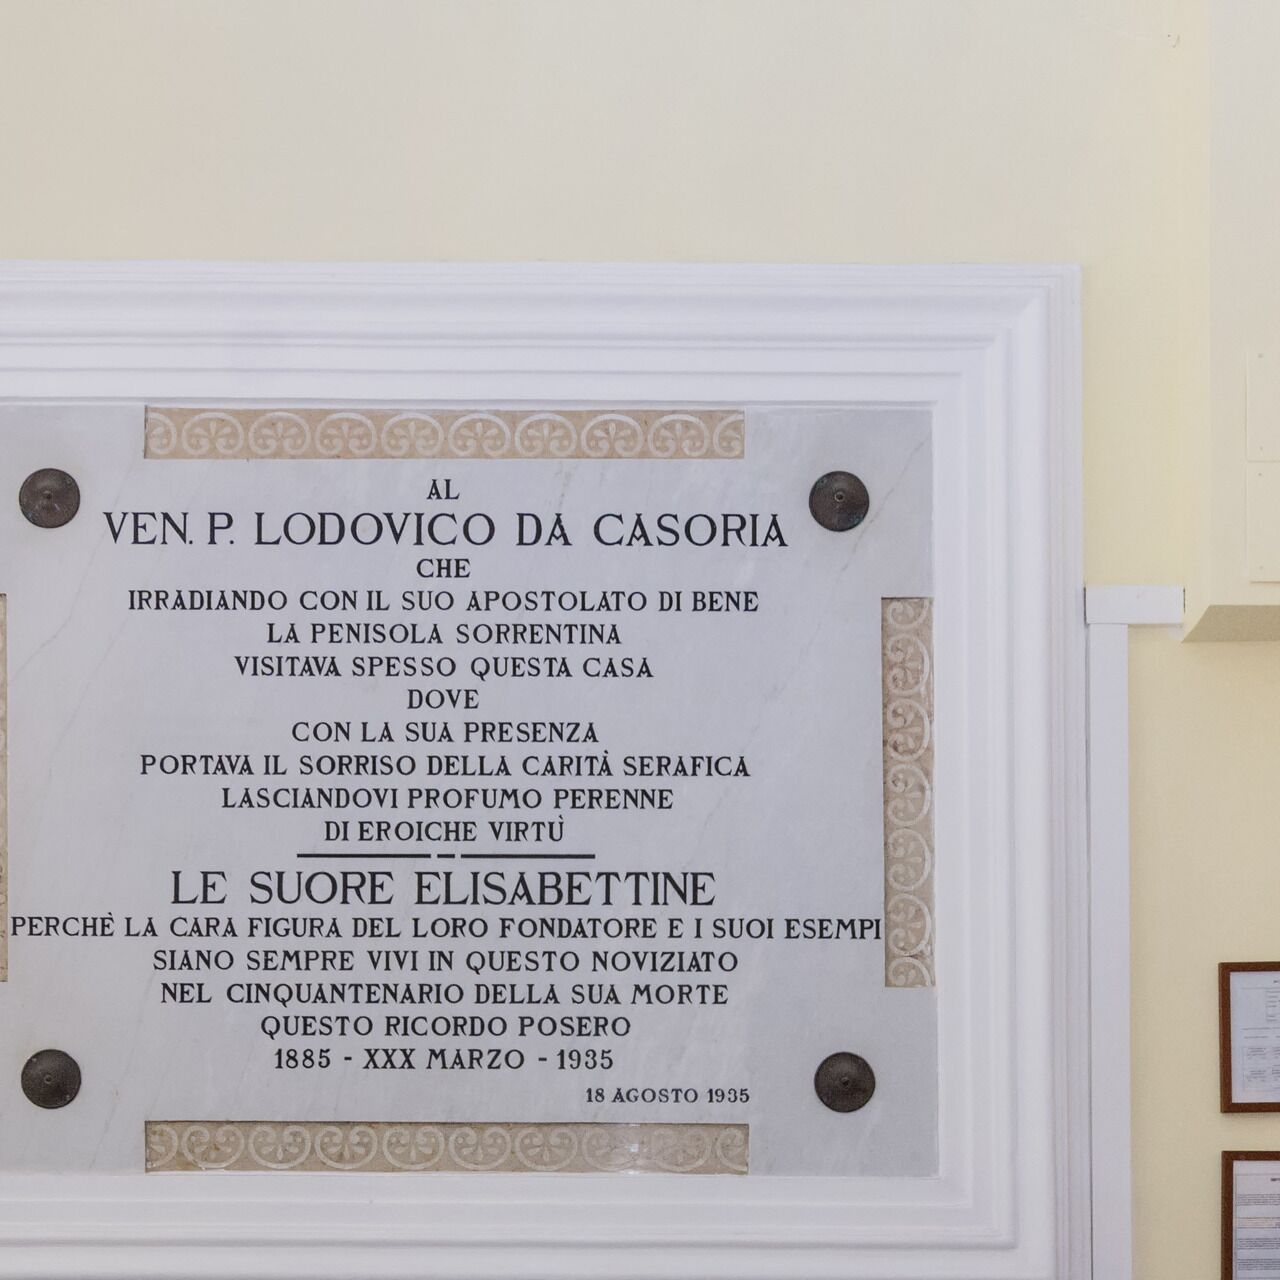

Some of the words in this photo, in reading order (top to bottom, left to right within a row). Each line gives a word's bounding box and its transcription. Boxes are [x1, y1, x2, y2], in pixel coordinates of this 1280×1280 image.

[426, 478, 460, 500] AL
[104, 511, 194, 545] VEN.
[207, 511, 235, 545] P.
[254, 511, 496, 546] LODOVICO
[515, 512, 573, 547] DA
[593, 512, 789, 548] CASORIA
[416, 558, 471, 579] CHE
[128, 589, 288, 611] IRRADIANDO
[299, 590, 359, 611] CON
[366, 590, 391, 612] IL
[401, 590, 455, 611] SUO
[465, 590, 648, 612] APOSTOLATO
[658, 590, 683, 612] DI
[691, 590, 759, 613] BENE
[266, 622, 301, 644] LA
[310, 622, 444, 645] PENISOLA
[456, 623, 622, 645] SORRENTINA
[233, 655, 343, 677] VISITAVA
[351, 656, 457, 678] SPESSO
[470, 656, 573, 682] QUESTA
[582, 657, 655, 678] CASA
[407, 688, 480, 710] DOVE
[291, 721, 352, 743] CON
[361, 721, 395, 743] LA
[405, 721, 455, 743] SUA
[463, 721, 600, 743] PRESENZA
[140, 754, 255, 776] PORTAVA
[263, 754, 288, 776] IL
[299, 754, 417, 776] SORRISO
[426, 754, 512, 777] DELLA
[521, 749, 614, 777] CARITÀ
[623, 755, 751, 777] SERAFICA
[221, 787, 399, 809] LASCIANDOVI
[407, 787, 543, 809] PROFUMO
[553, 788, 674, 810] PERENNE
[324, 820, 350, 842] DI
[357, 820, 478, 842] EROICHE
[487, 814, 565, 842] VIRTÙ
[170, 870, 228, 905] LE
[249, 870, 394, 905] SUORE
[413, 871, 716, 906] ELISABETTINE
[124, 916, 159, 937] LA
[169, 916, 239, 938] CARA
[247, 917, 343, 938] FIGURA
[351, 917, 402, 939] DEL
[411, 917, 489, 939] LORO
[498, 917, 657, 939] FONDATORE
[667, 917, 684, 939] E
[694, 917, 703, 939] I
[712, 917, 775, 940] SUOI
[783, 918, 882, 940] ESEMPI
[152, 949, 235, 971] SIANO
[246, 949, 355, 972] SEMPRE
[366, 950, 419, 972] VIVI
[428, 950, 455, 972] IN
[465, 950, 580, 976] QUESTO
[591, 950, 739, 973] NOVIZIATO
[160, 982, 213, 1004] NEL
[226, 982, 465, 1008] CINQUANTENARIO
[474, 983, 561, 1005] DELLA
[571, 983, 622, 1005] SUA
[630, 983, 729, 1005] MORTE
[260, 1015, 374, 1039] QUESTO
[384, 1015, 508, 1037] RICORDO
[517, 1015, 631, 1037] POSERO
[274, 1048, 331, 1070] 1885
[362, 1048, 416, 1070] XXX
[425, 1048, 525, 1070] MARZO
[556, 1048, 614, 1070] 1935
[586, 1087, 605, 1103] 18
[611, 1087, 699, 1104] AGOSTO
[707, 1087, 750, 1104] 1935
